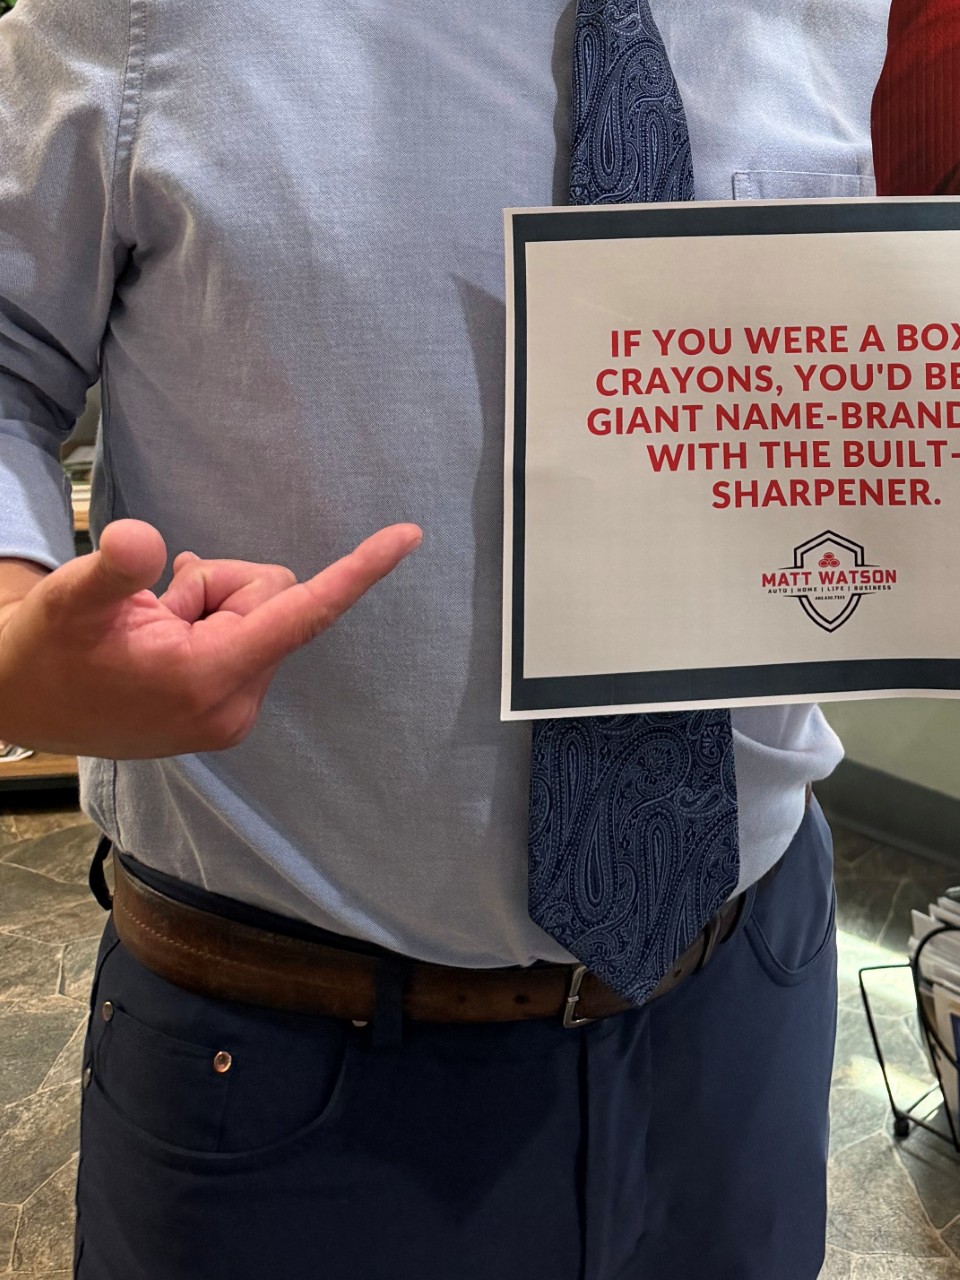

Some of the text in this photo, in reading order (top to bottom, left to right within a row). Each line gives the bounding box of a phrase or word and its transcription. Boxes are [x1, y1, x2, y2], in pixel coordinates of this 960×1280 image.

[610, 329, 641, 358] IF
[652, 327, 732, 357] YOU
[744, 325, 849, 355] WERE
[859, 324, 885, 353] A
[595, 365, 783, 398] CRAYONS,
[793, 362, 912, 392] YOU'D
[586, 404, 704, 437] GIANT
[646, 441, 747, 473] WITH
[759, 440, 831, 469] THE
[712, 477, 941, 510] SHARPENER.
[761, 569, 897, 587] MATT WATSON
